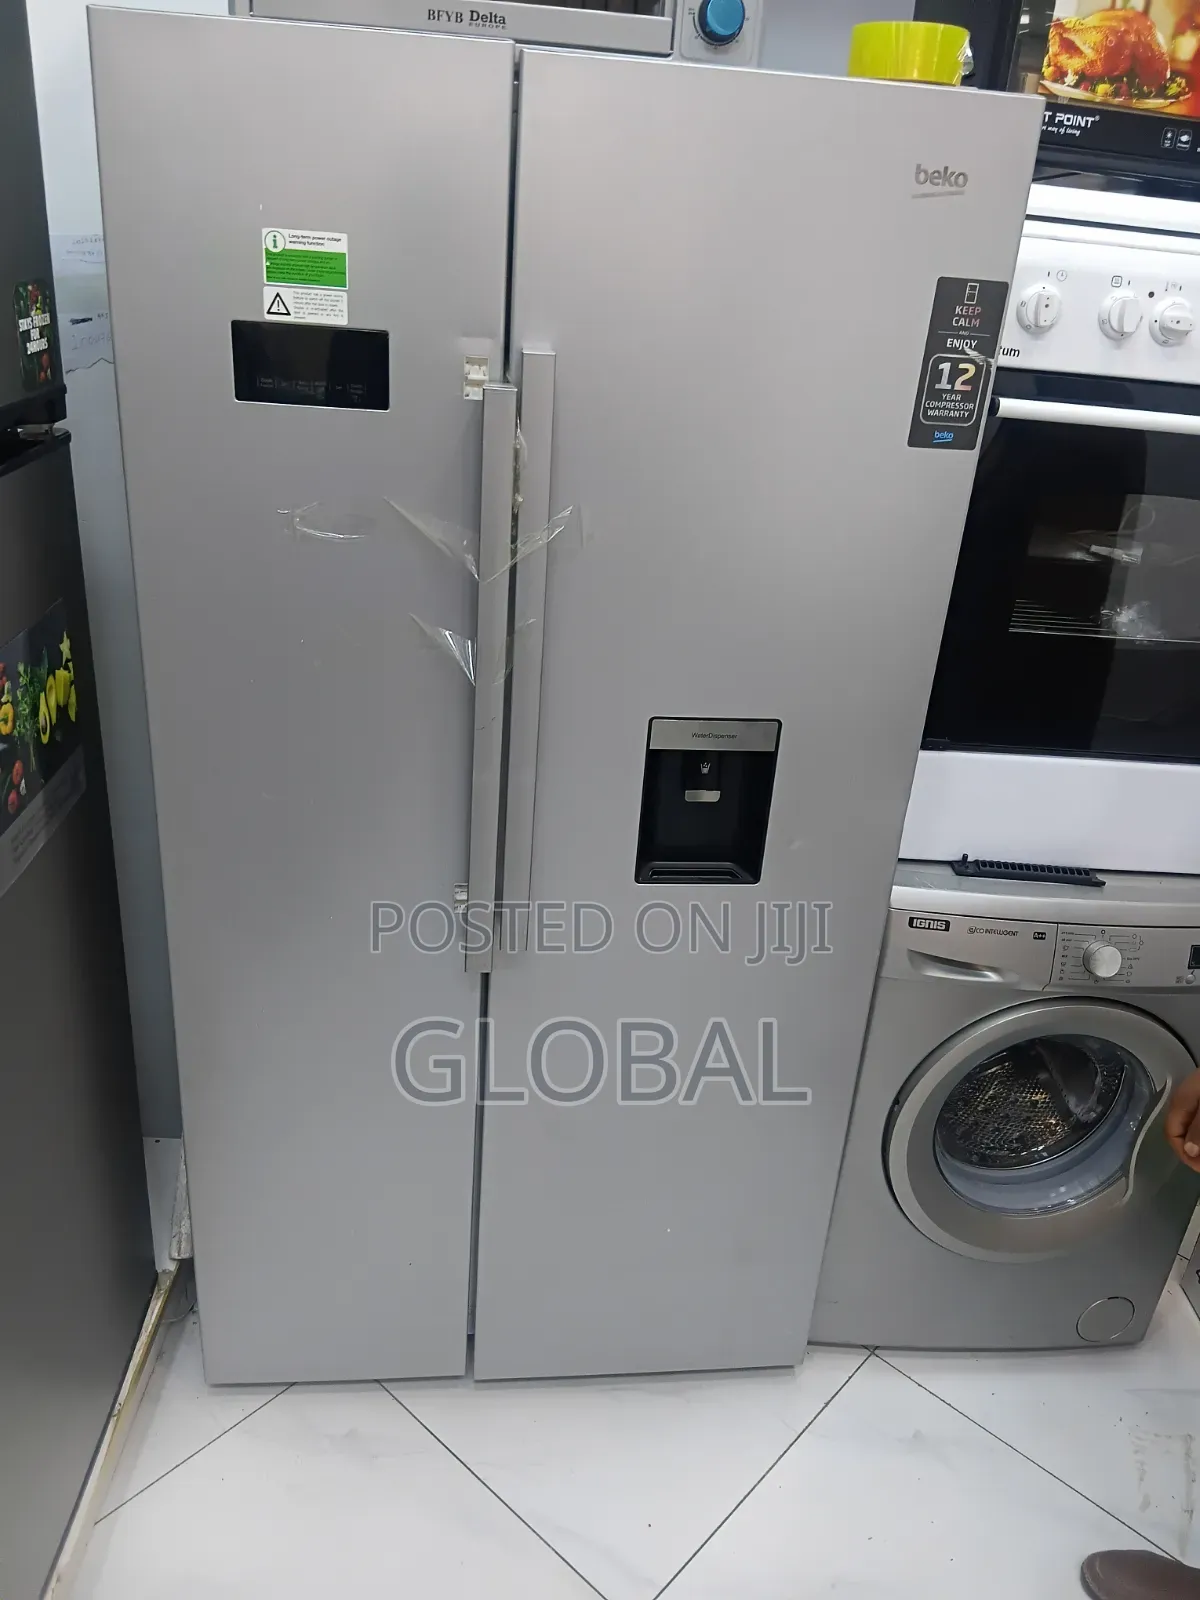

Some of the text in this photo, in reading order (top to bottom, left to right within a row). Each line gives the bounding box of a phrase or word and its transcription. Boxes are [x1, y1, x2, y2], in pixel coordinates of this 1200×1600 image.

[428, 9, 506, 25] BFYB Delta
[469, 22, 507, 30] EUROPE
[914, 163, 969, 188] beko
[955, 305, 982, 316] KEEP
[952, 317, 981, 327] CALM
[946, 338, 978, 351] ENJOY
[934, 362, 976, 391] 12
[942, 393, 962, 401] YEAR
[925, 400, 974, 410] COMPRESSOR
[927, 409, 970, 418] WARRANTY
[934, 430, 954, 439] beko
[911, 918, 946, 930] IGNIS
